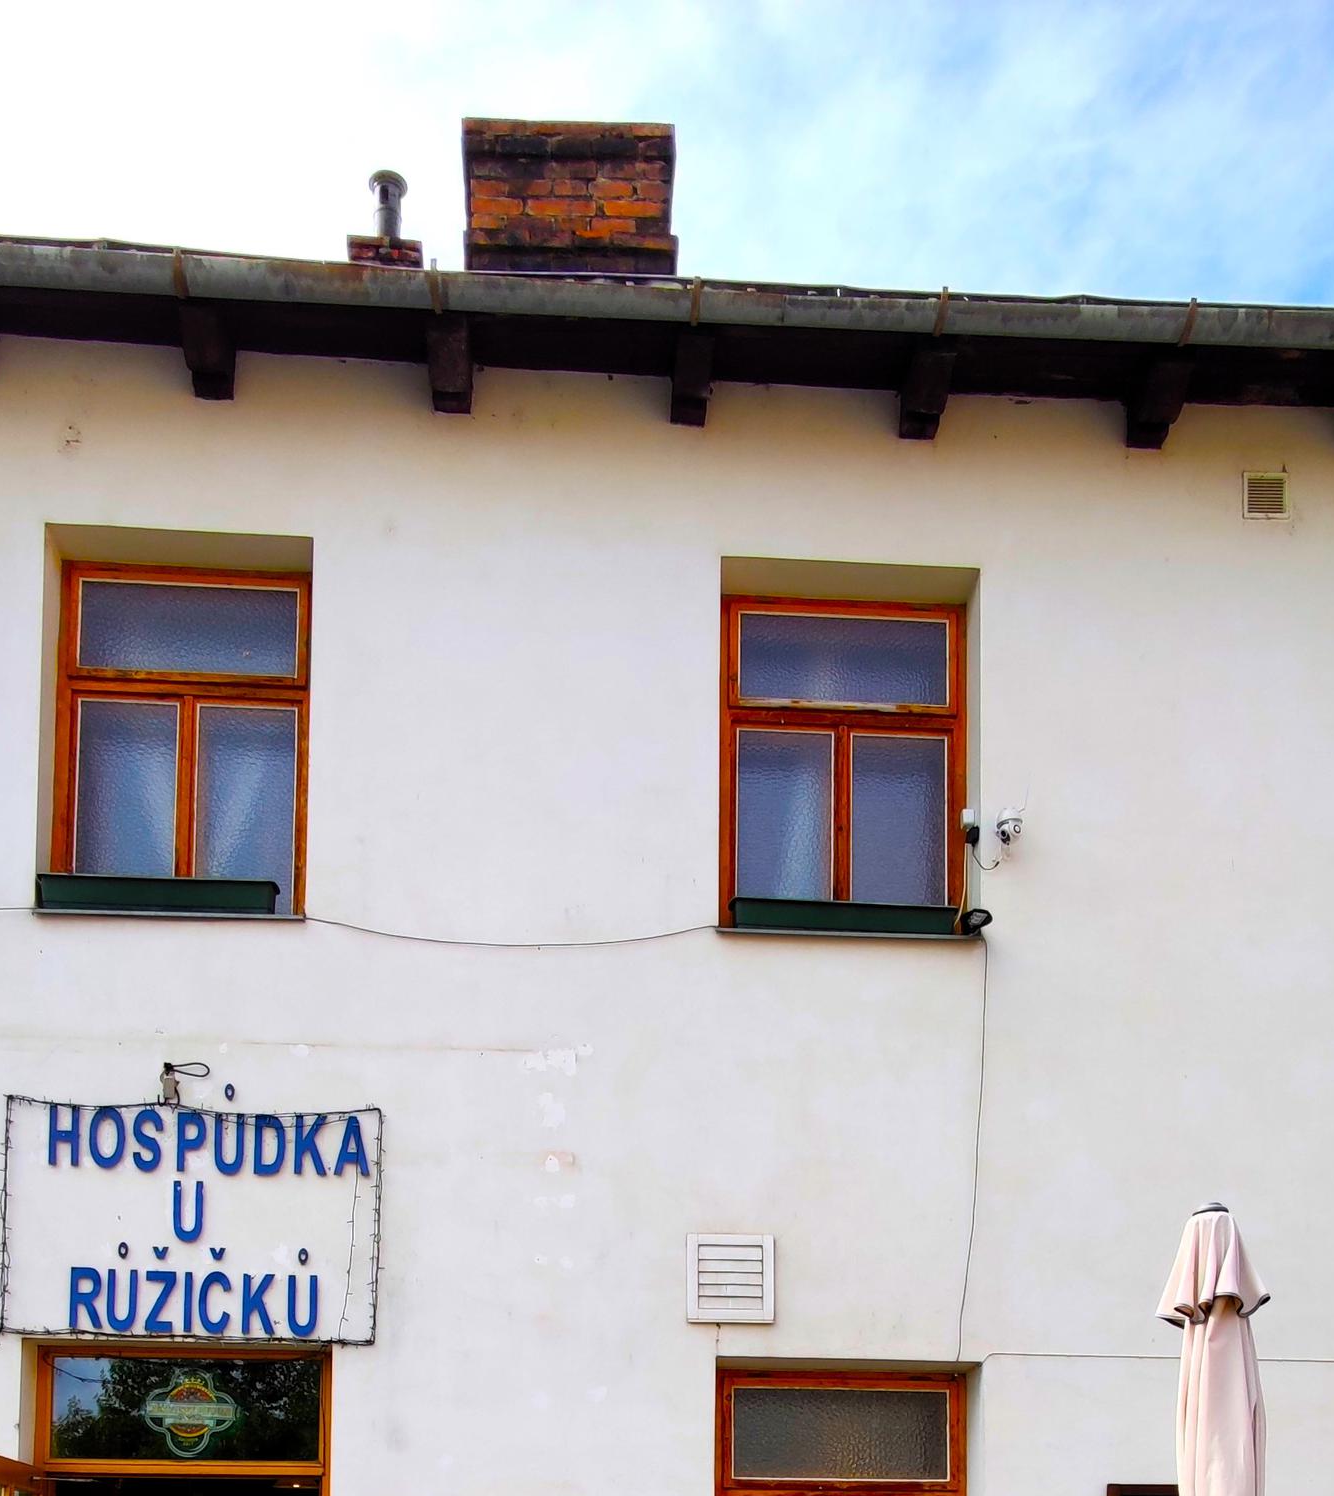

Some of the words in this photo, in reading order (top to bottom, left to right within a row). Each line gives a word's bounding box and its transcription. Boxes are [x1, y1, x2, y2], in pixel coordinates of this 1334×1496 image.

[48, 1083, 371, 1176] HOSPŮDKA
[173, 1180, 204, 1242] U
[69, 1242, 318, 1337] RŮŽIČKŮ
